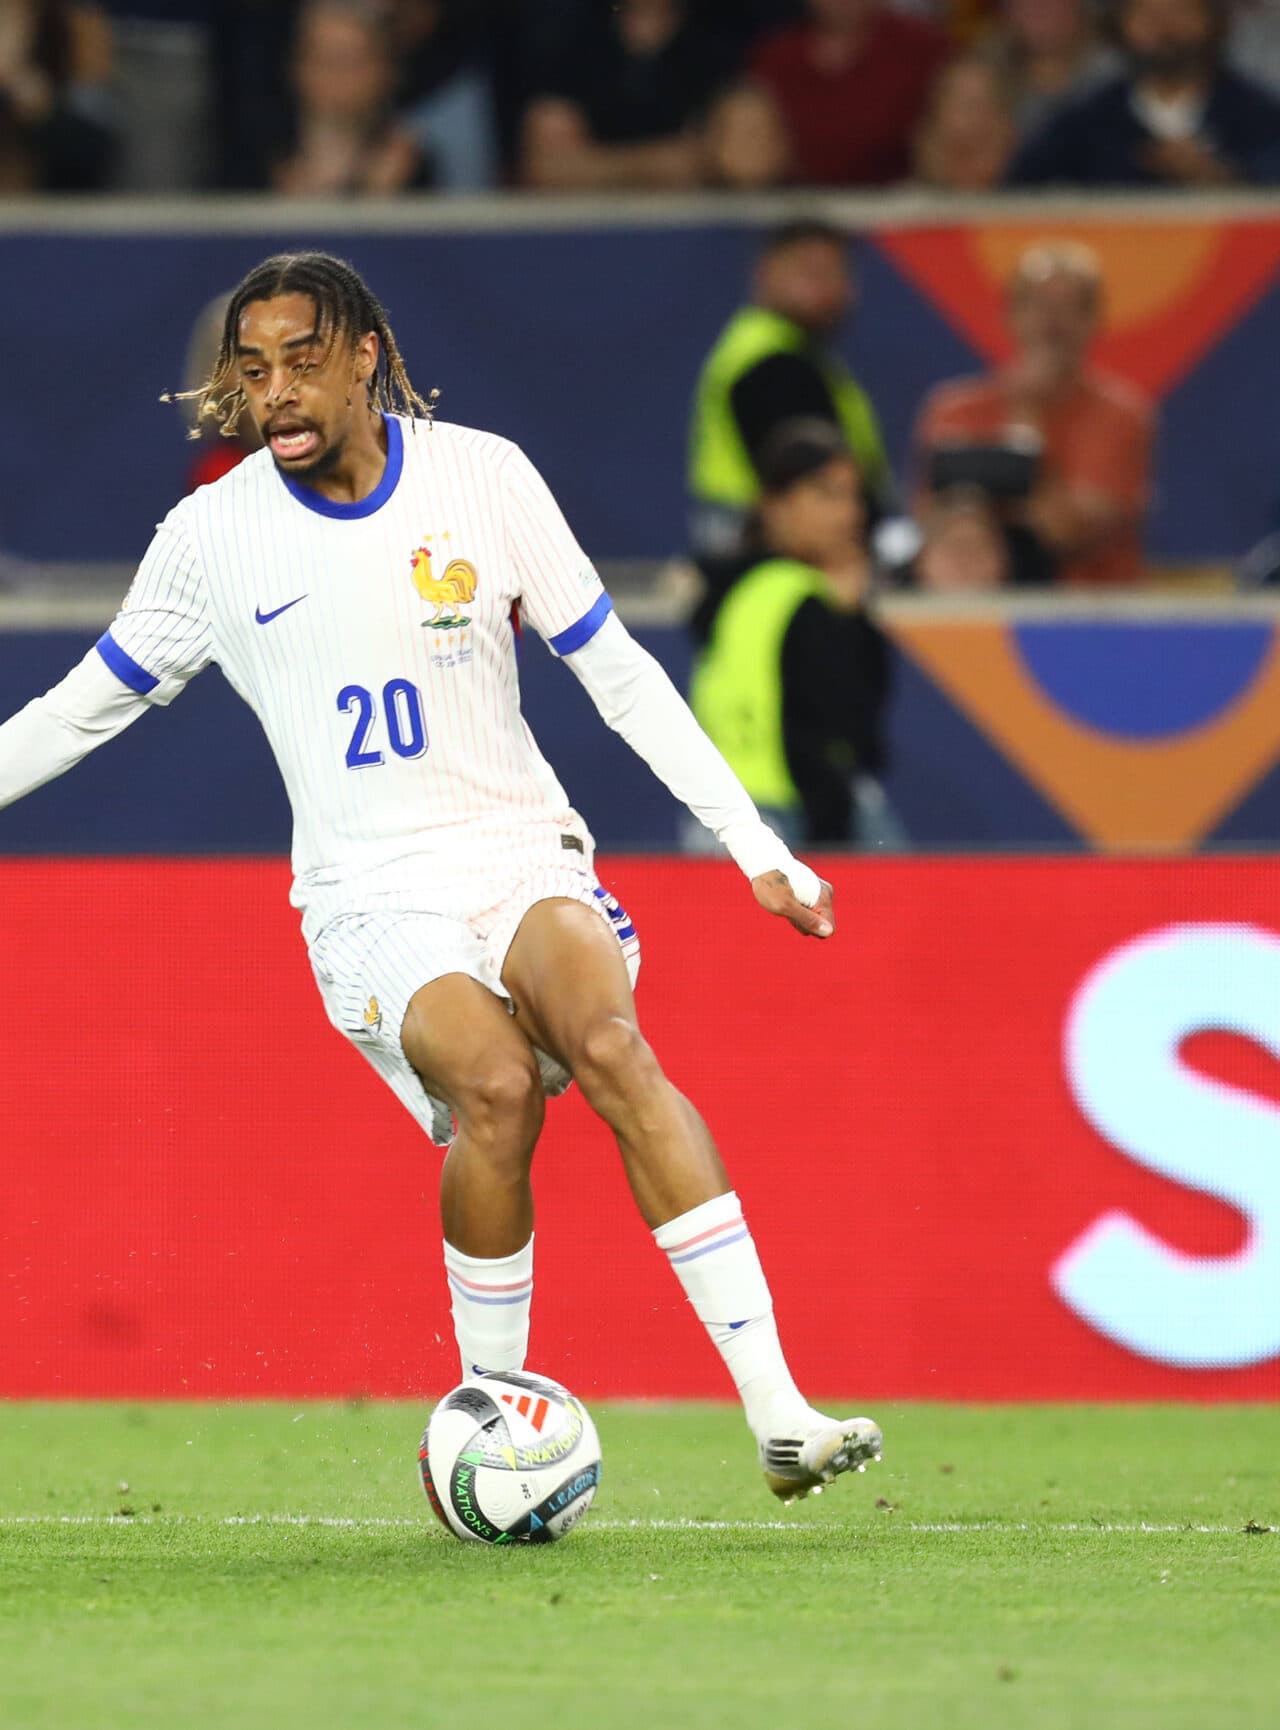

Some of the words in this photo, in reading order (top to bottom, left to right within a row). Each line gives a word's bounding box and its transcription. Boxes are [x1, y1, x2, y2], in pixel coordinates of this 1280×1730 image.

[336, 678, 429, 770] 20
[1048, 921, 1280, 1369] S
[456, 1468, 493, 1537] NATIONS
